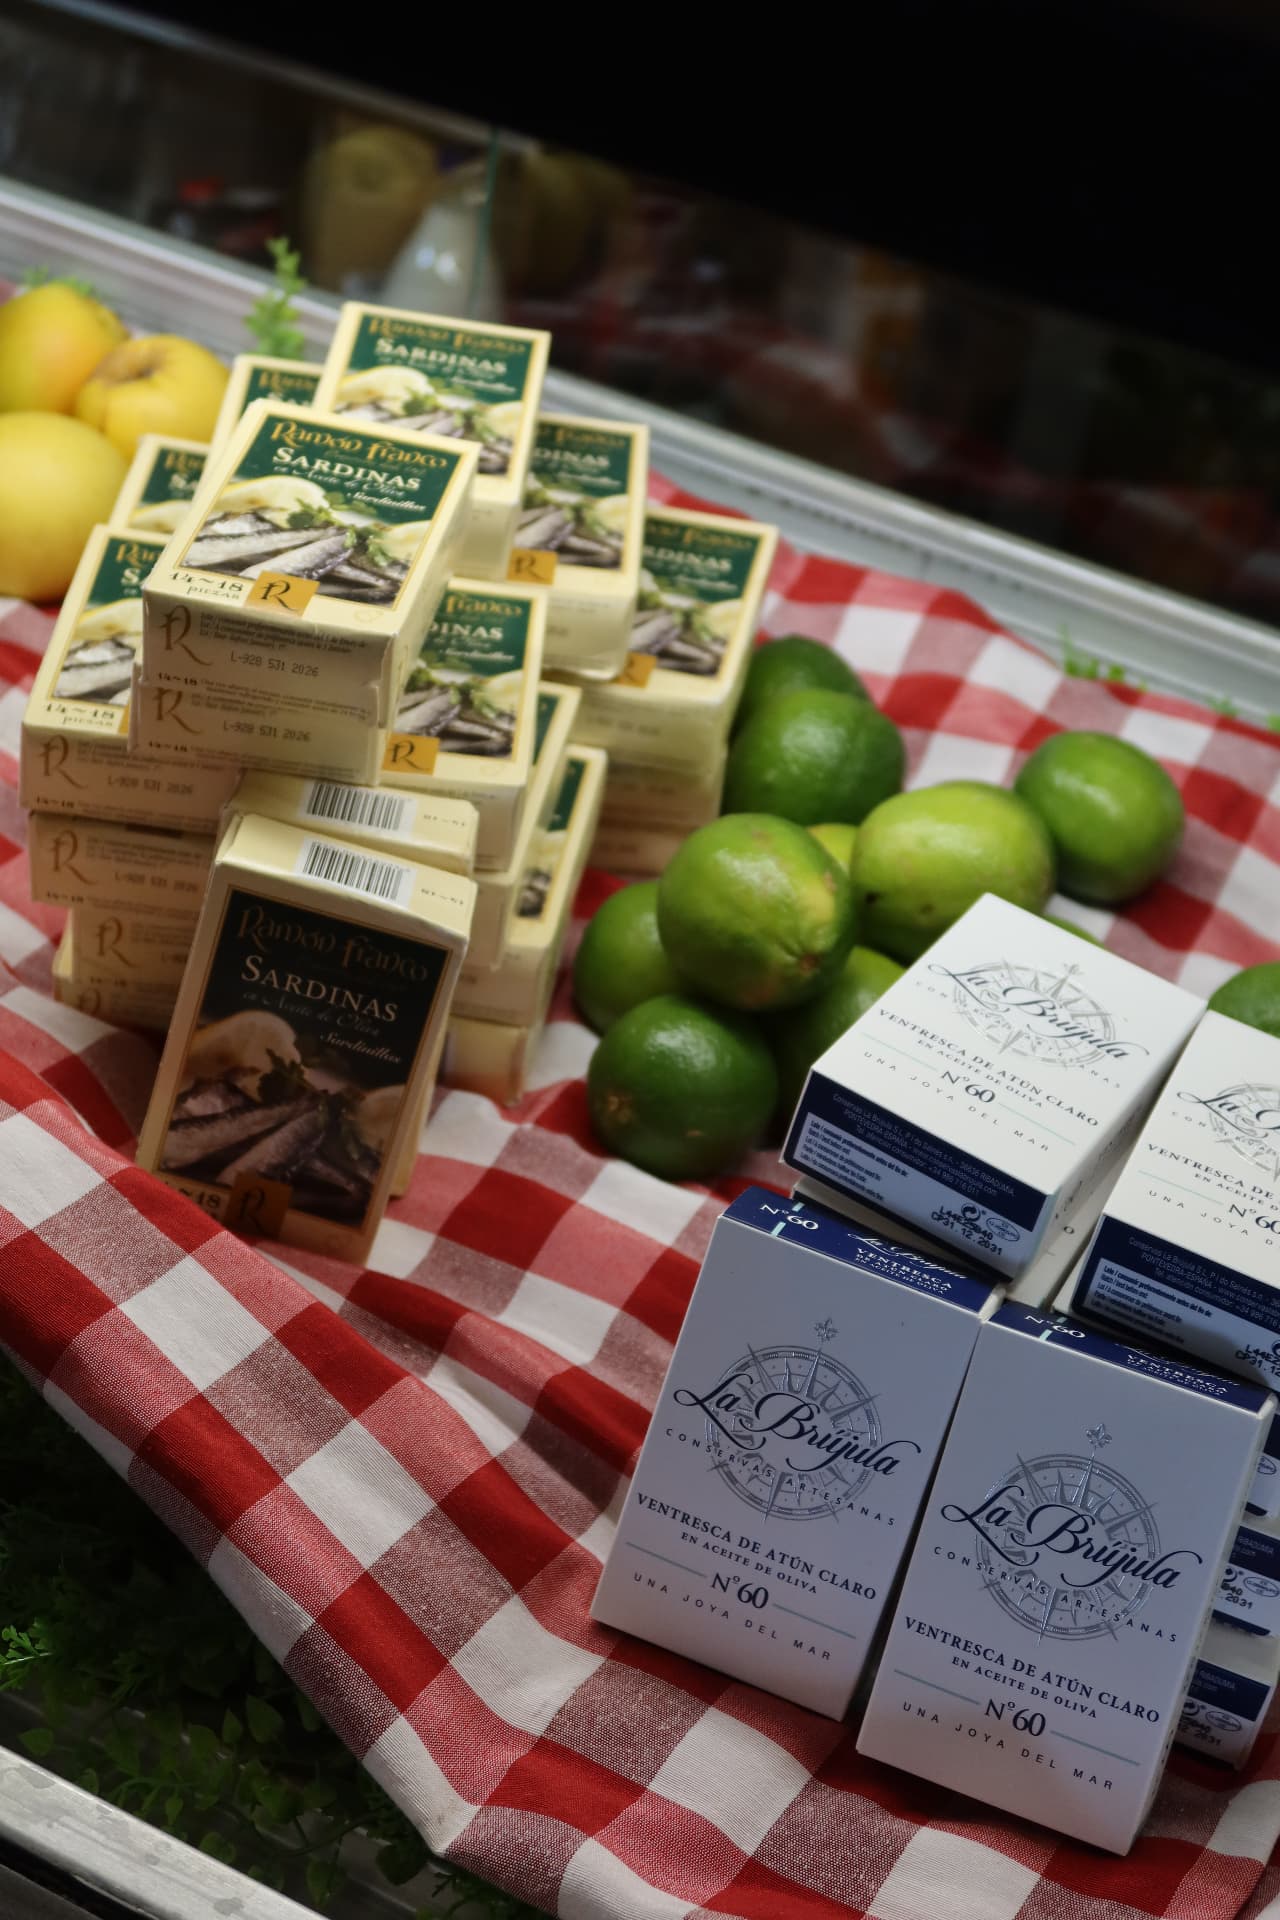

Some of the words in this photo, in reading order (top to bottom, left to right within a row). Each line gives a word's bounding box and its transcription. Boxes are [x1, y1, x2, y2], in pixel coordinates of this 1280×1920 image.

[376, 337, 507, 374] SARDINAS
[273, 446, 422, 491] SARDINAS
[241, 955, 399, 1023] SARDINAS
[928, 963, 1010, 1013] La
[987, 986, 1150, 1059] Brújula
[880, 1008, 966, 1057] VENTRESCA
[972, 1055, 994, 1071] DE
[999, 1069, 1044, 1096] ATÚN
[1046, 1095, 1099, 1128] CLARO
[1013, 1129, 1050, 1152] MAR
[1177, 1091, 1268, 1139] La
[1148, 1143, 1245, 1188] VENTRESCA
[1252, 1185, 1274, 1200] DE
[857, 1247, 953, 1290] VENTRESCA
[673, 1373, 767, 1450] La
[739, 1392, 921, 1477] Brújula
[666, 1428, 774, 1478] CONSERVAS
[785, 1478, 896, 1527] ARTESANAS
[636, 1493, 732, 1543] VENTRESCA
[738, 1535, 760, 1554] DE
[766, 1547, 815, 1576] ATÚN
[818, 1568, 877, 1600] CLARO
[681, 1532, 698, 1545] EN
[703, 1541, 750, 1567] ACEITE
[755, 1562, 772, 1576] DE
[777, 1571, 818, 1595] OLIVA
[941, 1485, 1040, 1567] La
[1010, 1503, 1203, 1589] Brújula
[633, 1572, 669, 1594] UNA
[682, 1594, 730, 1620] JOYA
[744, 1619, 778, 1640] DEL
[793, 1639, 832, 1661] MAR
[934, 1546, 1047, 1596] CONSERVAS
[1060, 1593, 1178, 1643] ARTESANAS
[905, 1616, 1006, 1667] VENTRESCA
[1012, 1658, 1036, 1678] DE
[1042, 1671, 1094, 1699] ATÚN
[1097, 1691, 1160, 1723] CLARO
[951, 1656, 971, 1669] EN
[974, 1666, 1026, 1691] ACEITE
[1030, 1686, 1049, 1700] DE
[1053, 1695, 1097, 1718] OLIVA
[902, 1702, 940, 1724] UNA
[954, 1723, 1006, 1749] JOYA
[1020, 1748, 1057, 1769] DEL
[1073, 1768, 1114, 1791] MAR
